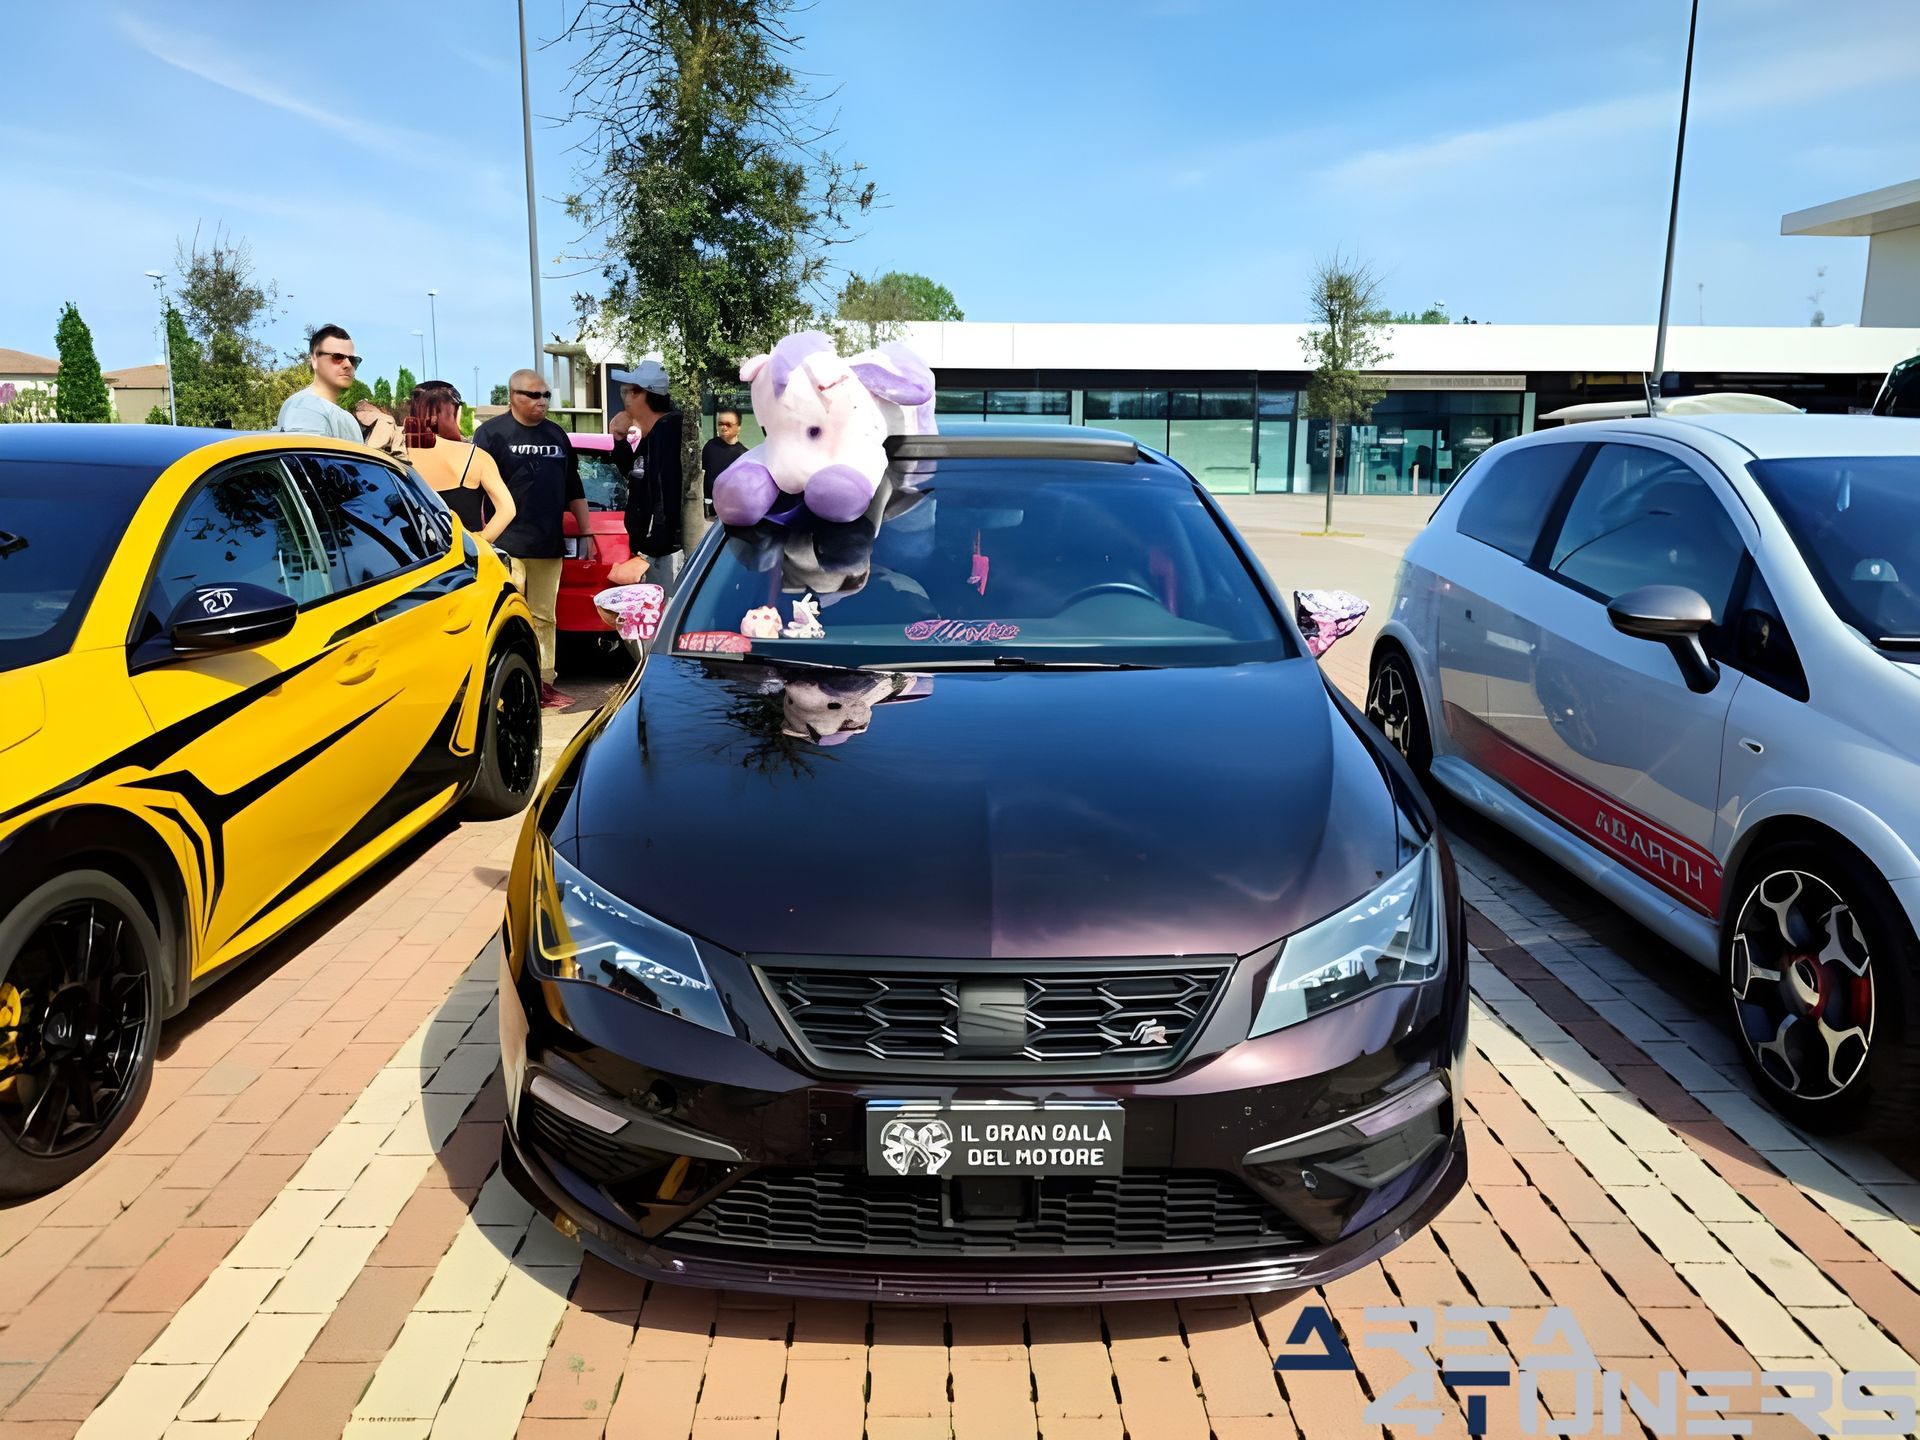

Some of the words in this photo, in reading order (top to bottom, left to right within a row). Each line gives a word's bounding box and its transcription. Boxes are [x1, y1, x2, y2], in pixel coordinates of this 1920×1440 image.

[1595, 809, 1703, 891] ABARTH
[960, 1124, 980, 1143] IL
[967, 1149, 1011, 1167] DEL
[1015, 1148, 1105, 1167] MOTORE
